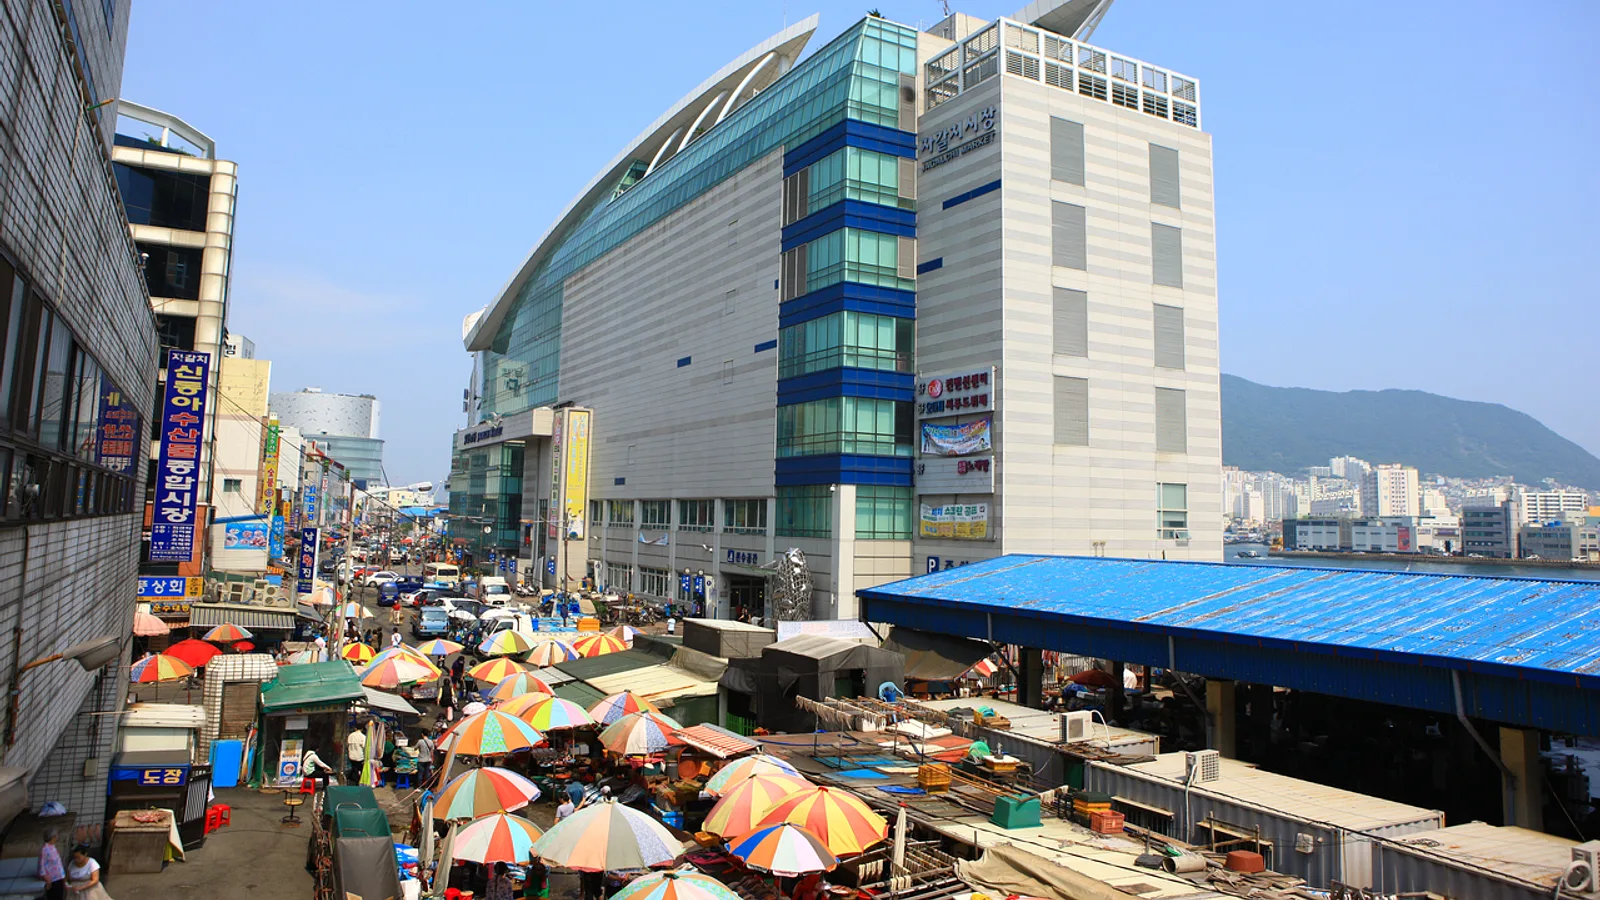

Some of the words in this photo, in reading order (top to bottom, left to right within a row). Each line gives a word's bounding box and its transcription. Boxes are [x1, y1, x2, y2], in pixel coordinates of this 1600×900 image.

[921, 106, 997, 154] 자갈치시장
[961, 132, 996, 155] MARKET
[171, 352, 208, 364] 자갈치
[944, 506, 963, 516] 스크린
[964, 506, 978, 517] 골프
[143, 768, 183, 784] 도장
